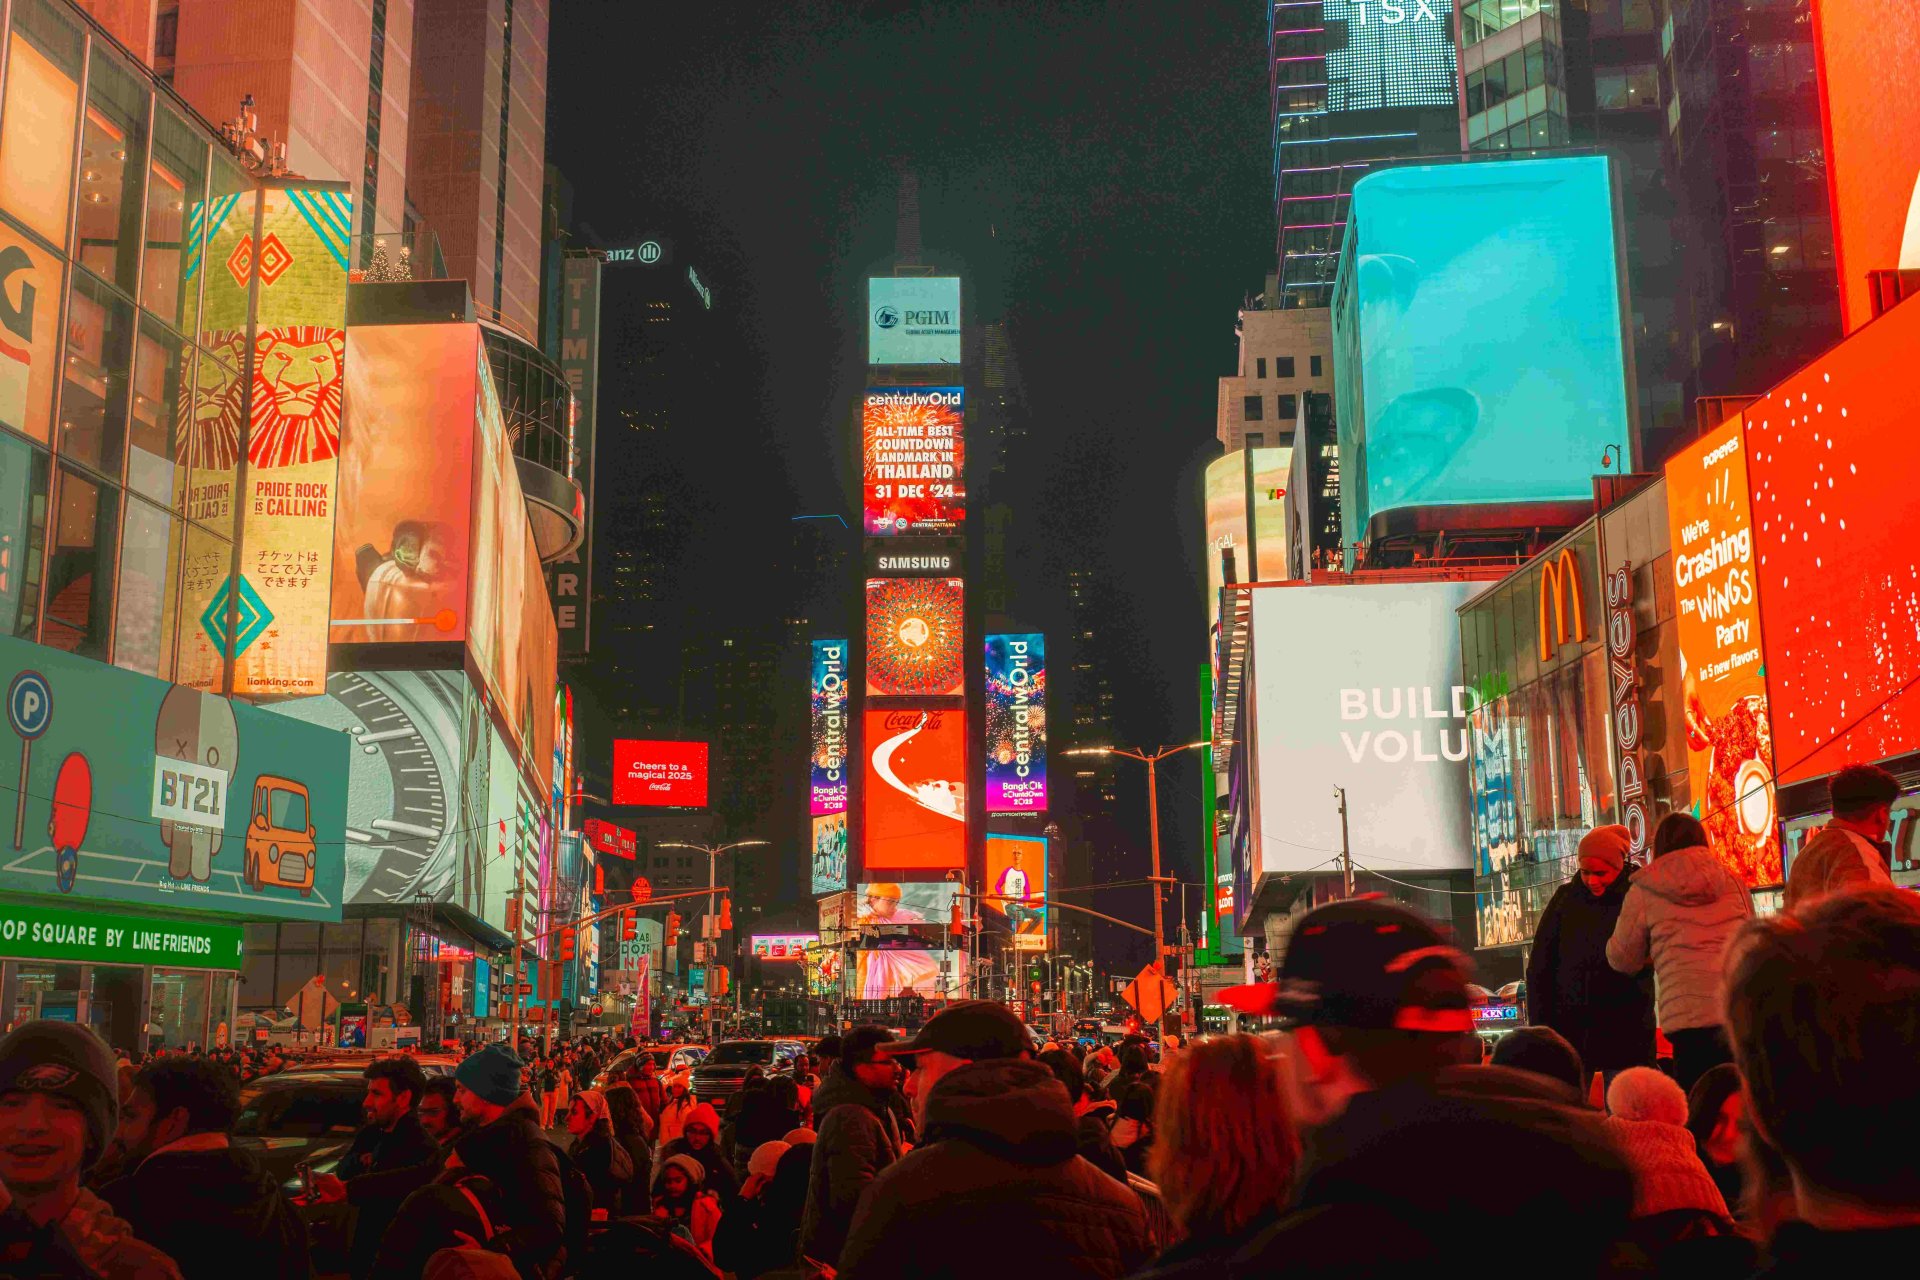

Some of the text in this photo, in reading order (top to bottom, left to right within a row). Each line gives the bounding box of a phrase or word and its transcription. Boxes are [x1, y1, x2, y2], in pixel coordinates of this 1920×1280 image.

[904, 310, 950, 325] PGIM
[875, 426, 954, 437] ALL-TIME BEST
[875, 438, 954, 451] COUNTDOWN
[875, 452, 954, 463] LANDMARK IN
[1702, 436, 1739, 469] POPEYES
[875, 464, 954, 479] THAILAND
[256, 481, 328, 499] PRIDE ROCK
[875, 484, 892, 498] 31
[898, 484, 925, 498] DEC
[255, 498, 327, 517] IS CALLING
[1681, 519, 1710, 545] We're
[258, 550, 319, 563] チケットは
[879, 557, 950, 569] SAMSUNG
[1675, 526, 1750, 587] Crashing
[257, 563, 318, 576] ここで入手
[263, 577, 311, 589] できます
[1680, 597, 1695, 615] The
[1716, 618, 1749, 649] Party
[1699, 647, 1759, 681] in 5 new flavors
[247, 677, 314, 687] lionking.com
[1340, 684, 1478, 720] BUILD
[633, 762, 667, 771] Cheers
[669, 763, 679, 771] to
[628, 771, 692, 780] magical 2025
[160, 769, 220, 816] BT21
[0, 919, 27, 940] OP
[32, 922, 97, 946] SQUARE
[105, 928, 124, 948] BY
[132, 931, 160, 951] LINE
[162, 933, 211, 954] FRIENDS
